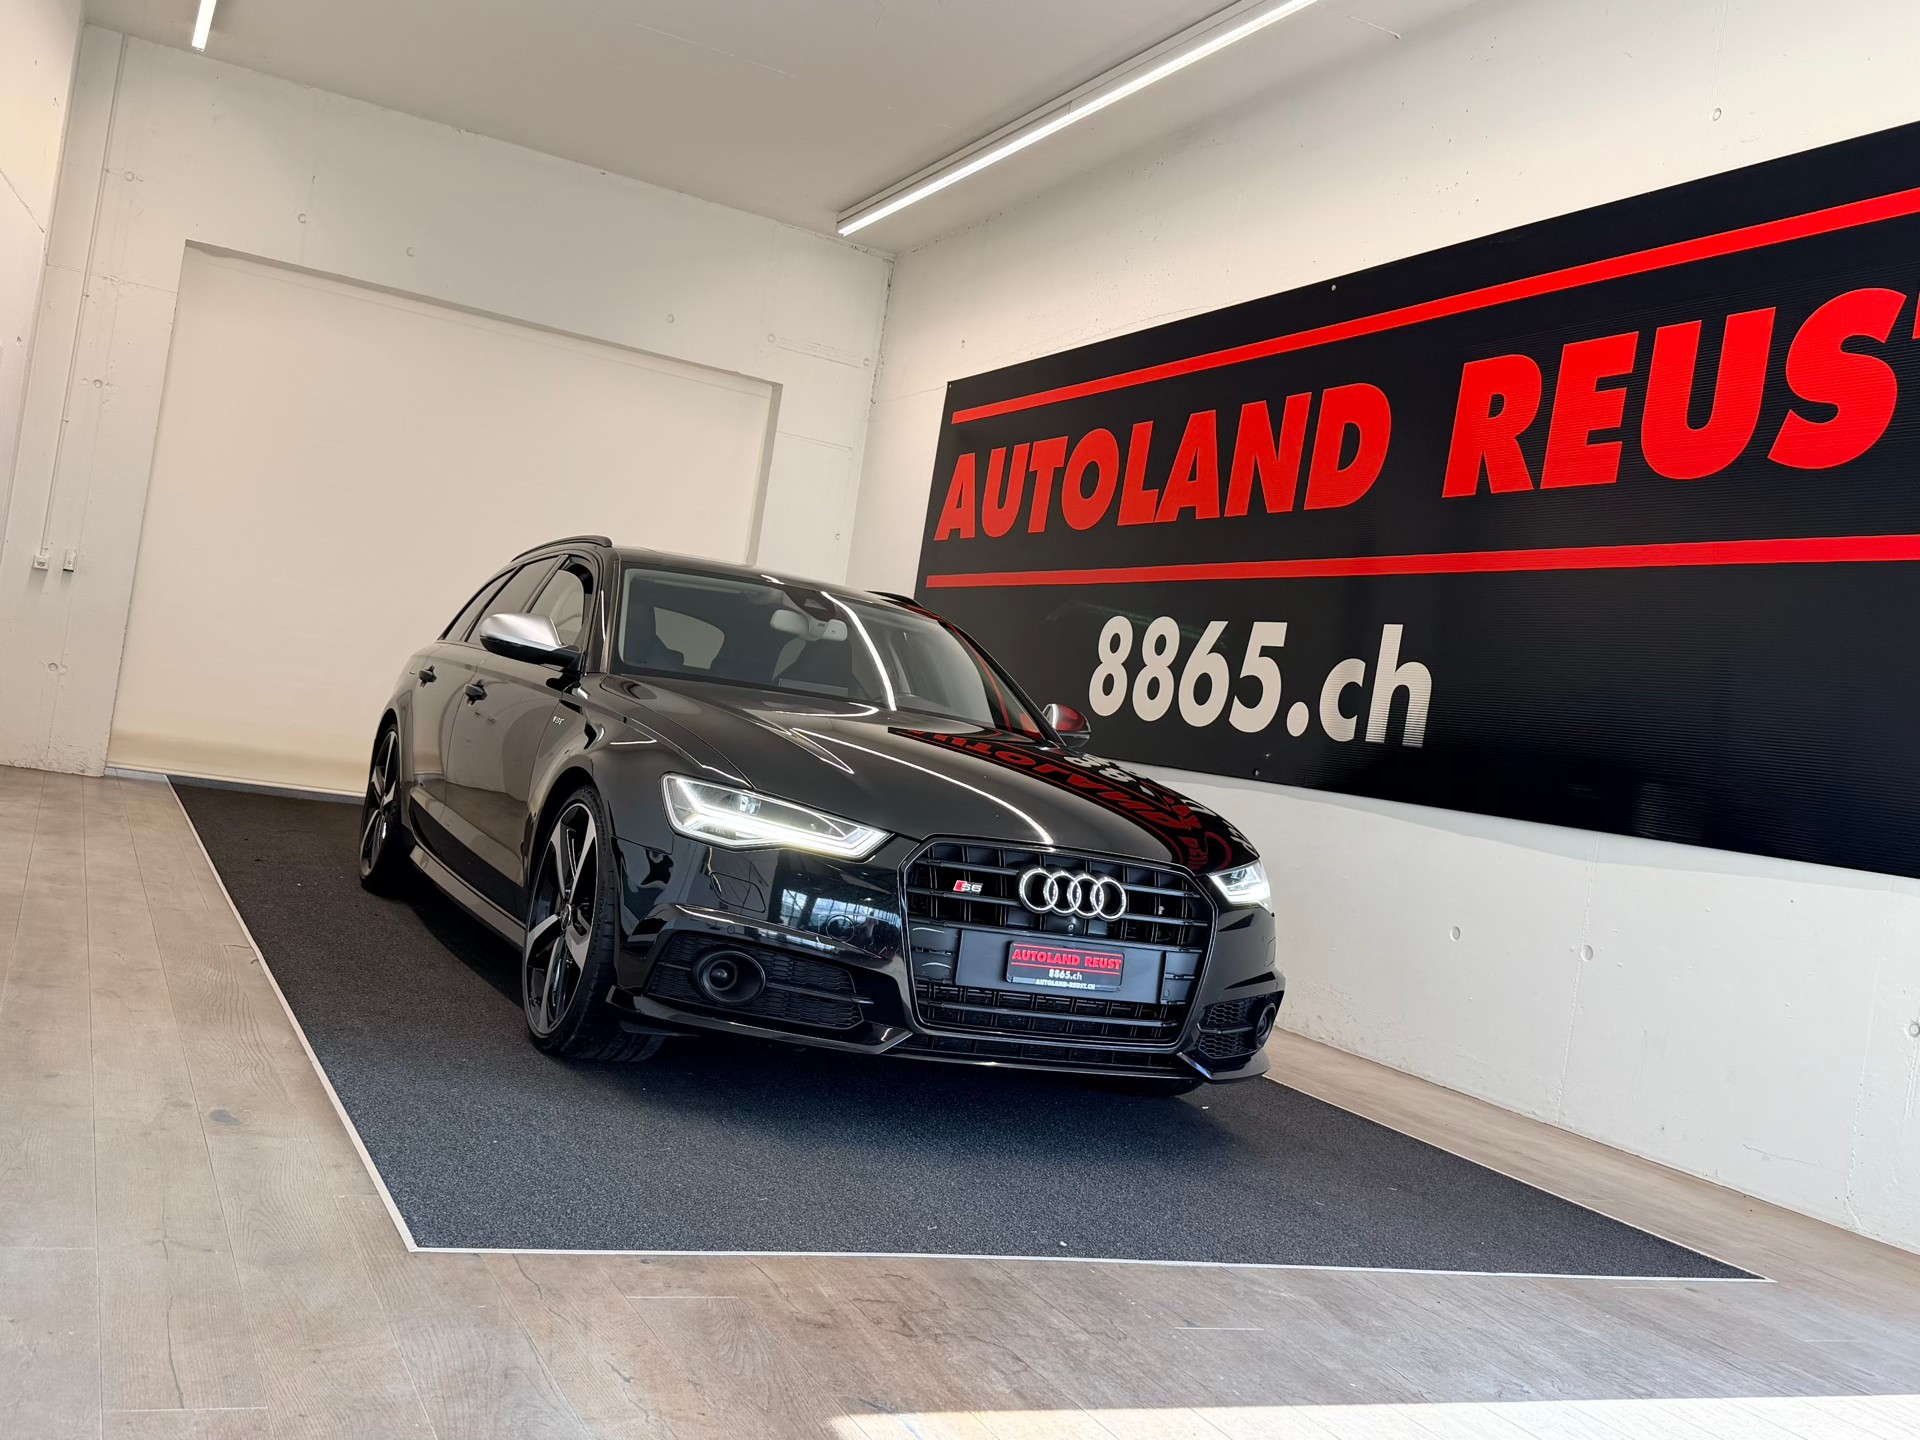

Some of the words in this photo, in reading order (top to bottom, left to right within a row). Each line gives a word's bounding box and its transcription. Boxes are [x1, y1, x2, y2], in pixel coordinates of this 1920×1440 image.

[934, 382, 1392, 541] AUTOLAND
[1442, 287, 1920, 499] REUS
[1088, 615, 1433, 748] 8865.ch
[1011, 949, 1081, 966] AUTOLAND
[1084, 956, 1122, 970] REUST
[1035, 979, 1096, 990] AUTOLAND-REUST.CH
[1048, 969, 1083, 981] 8865.ch
